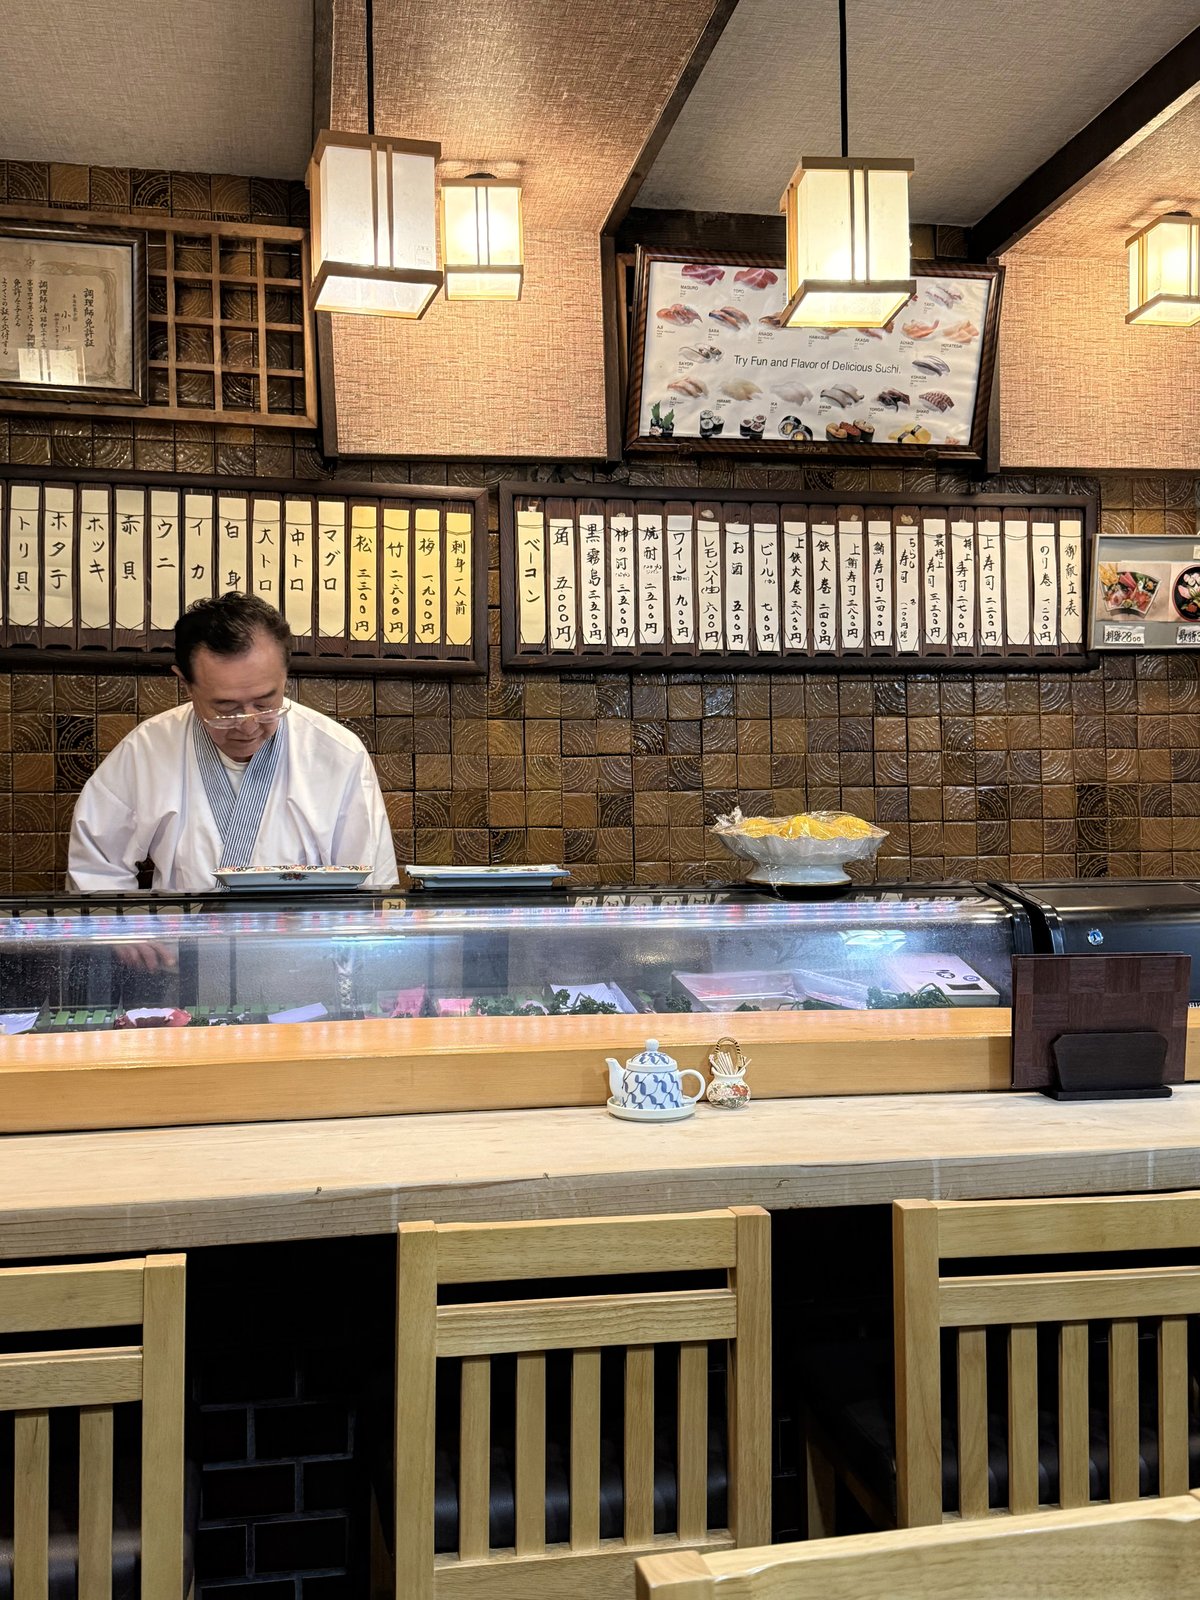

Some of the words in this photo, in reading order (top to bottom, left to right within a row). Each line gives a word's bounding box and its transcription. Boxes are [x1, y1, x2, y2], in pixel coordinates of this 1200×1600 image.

[83, 288, 95, 347] 調理師免許証
[734, 354, 748, 367] Try
[750, 356, 768, 367] Fun
[770, 357, 788, 368] and
[790, 358, 818, 370] Flavor
[820, 359, 830, 370] of
[832, 360, 873, 373] Delicious
[874, 363, 901, 374] Sushi.
[14, 516, 30, 591] トリ貝
[49, 512, 68, 589] ホタテ
[121, 515, 141, 581] 赤貝
[156, 518, 176, 569] ウニ
[190, 519, 205, 580] イカ
[224, 520, 241, 591] 白身
[255, 527, 274, 592] 大トロ
[290, 528, 305, 592] 中トロ
[323, 529, 341, 591] マグロ
[353, 534, 373, 553] 松
[386, 541, 405, 558] 竹
[553, 527, 569, 546] 角
[585, 523, 601, 587] 黒霧島
[614, 527, 629, 571] 神の河
[642, 525, 659, 561] 焼酎
[672, 532, 687, 575] ワイン
[731, 541, 745, 576] お酒
[908, 537, 917, 569] ちらし
[934, 533, 945, 569] 最特上
[963, 538, 973, 562] 特上
[450, 539, 467, 616] 刺身一人前
[524, 538, 541, 603] ベーコン
[788, 536, 805, 595] 上鉄火巻
[815, 539, 832, 595] 鉄火巻
[845, 543, 861, 597] 上鮪寿司
[873, 541, 885, 592] 鮪寿司
[899, 549, 909, 584] 寿司
[926, 556, 936, 588] 寿司
[955, 560, 968, 592] 寿司
[983, 536, 995, 591] 上寿司
[1039, 545, 1053, 587] のり巻
[1064, 543, 1080, 617] 御献立表
